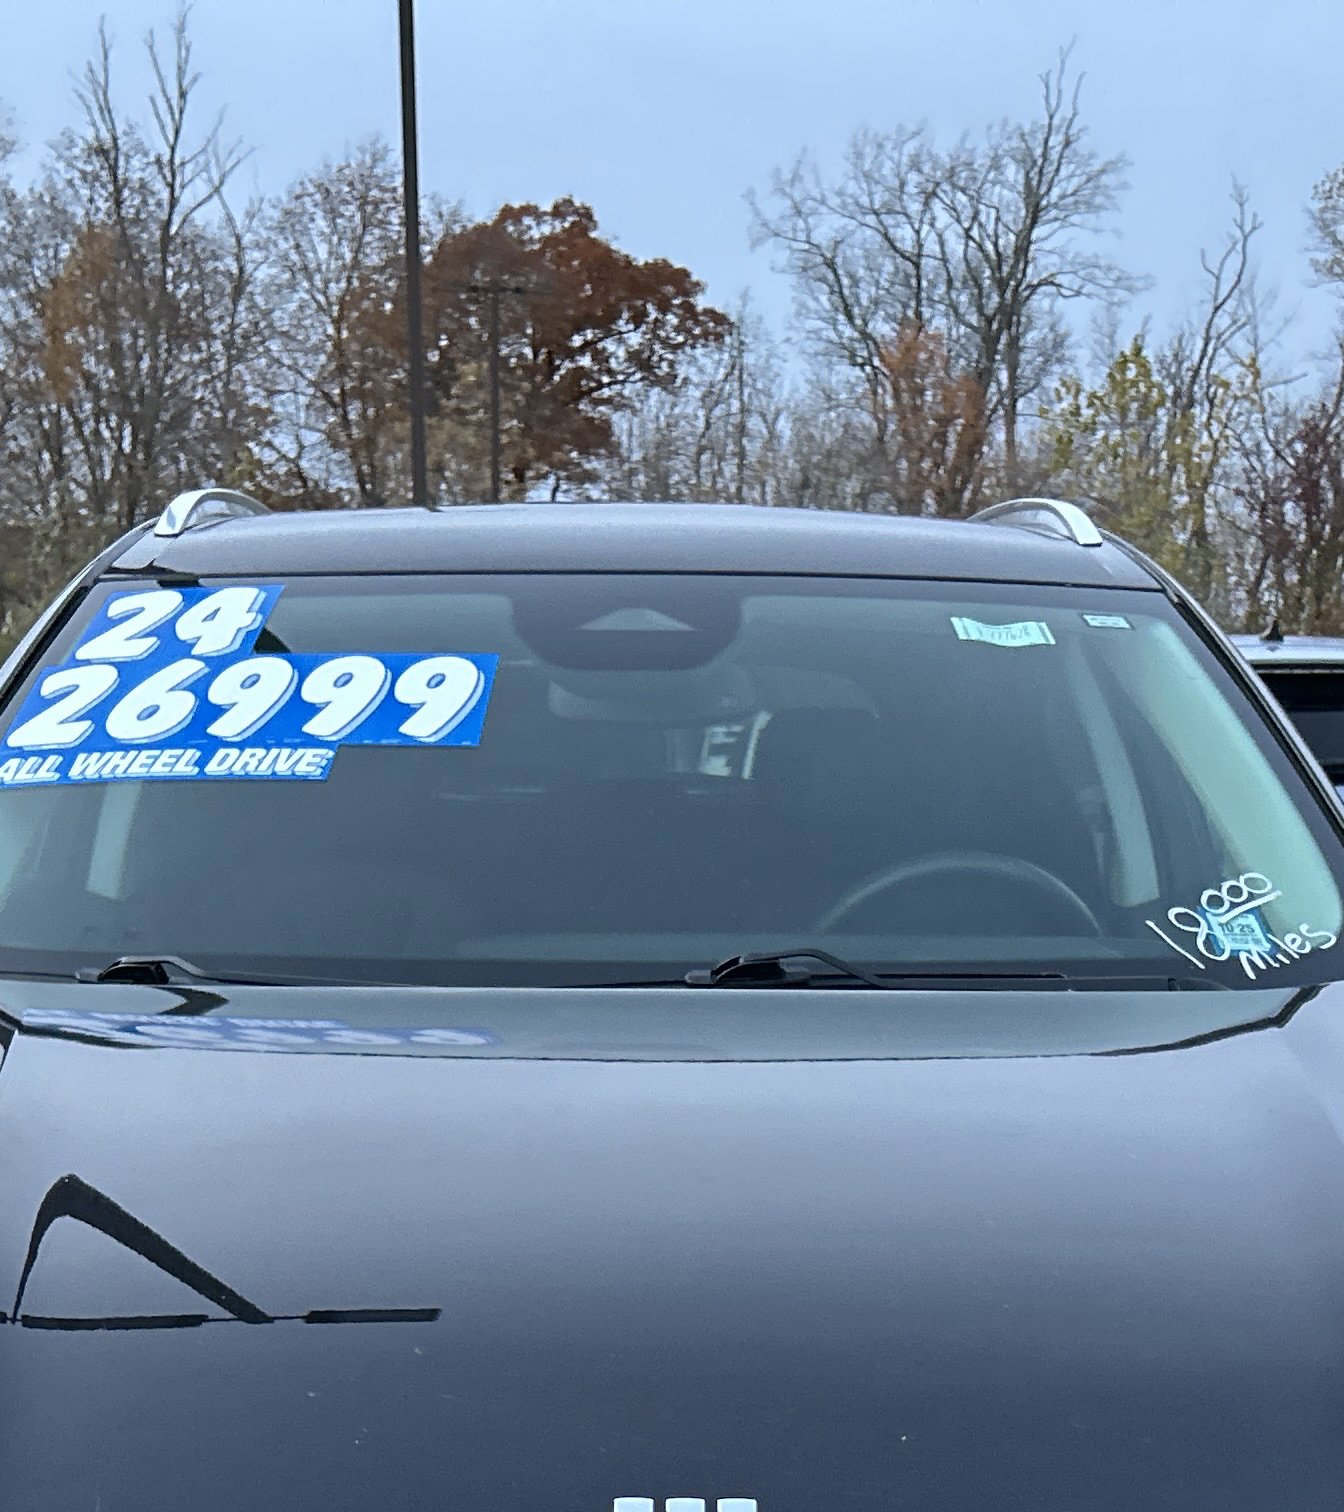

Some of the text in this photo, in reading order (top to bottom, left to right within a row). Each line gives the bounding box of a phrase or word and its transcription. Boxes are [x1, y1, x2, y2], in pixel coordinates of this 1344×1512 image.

[75, 586, 268, 662] 24
[6, 655, 486, 750] 26999
[68, 748, 203, 780] WHEEL
[204, 747, 336, 779] DRIVE
